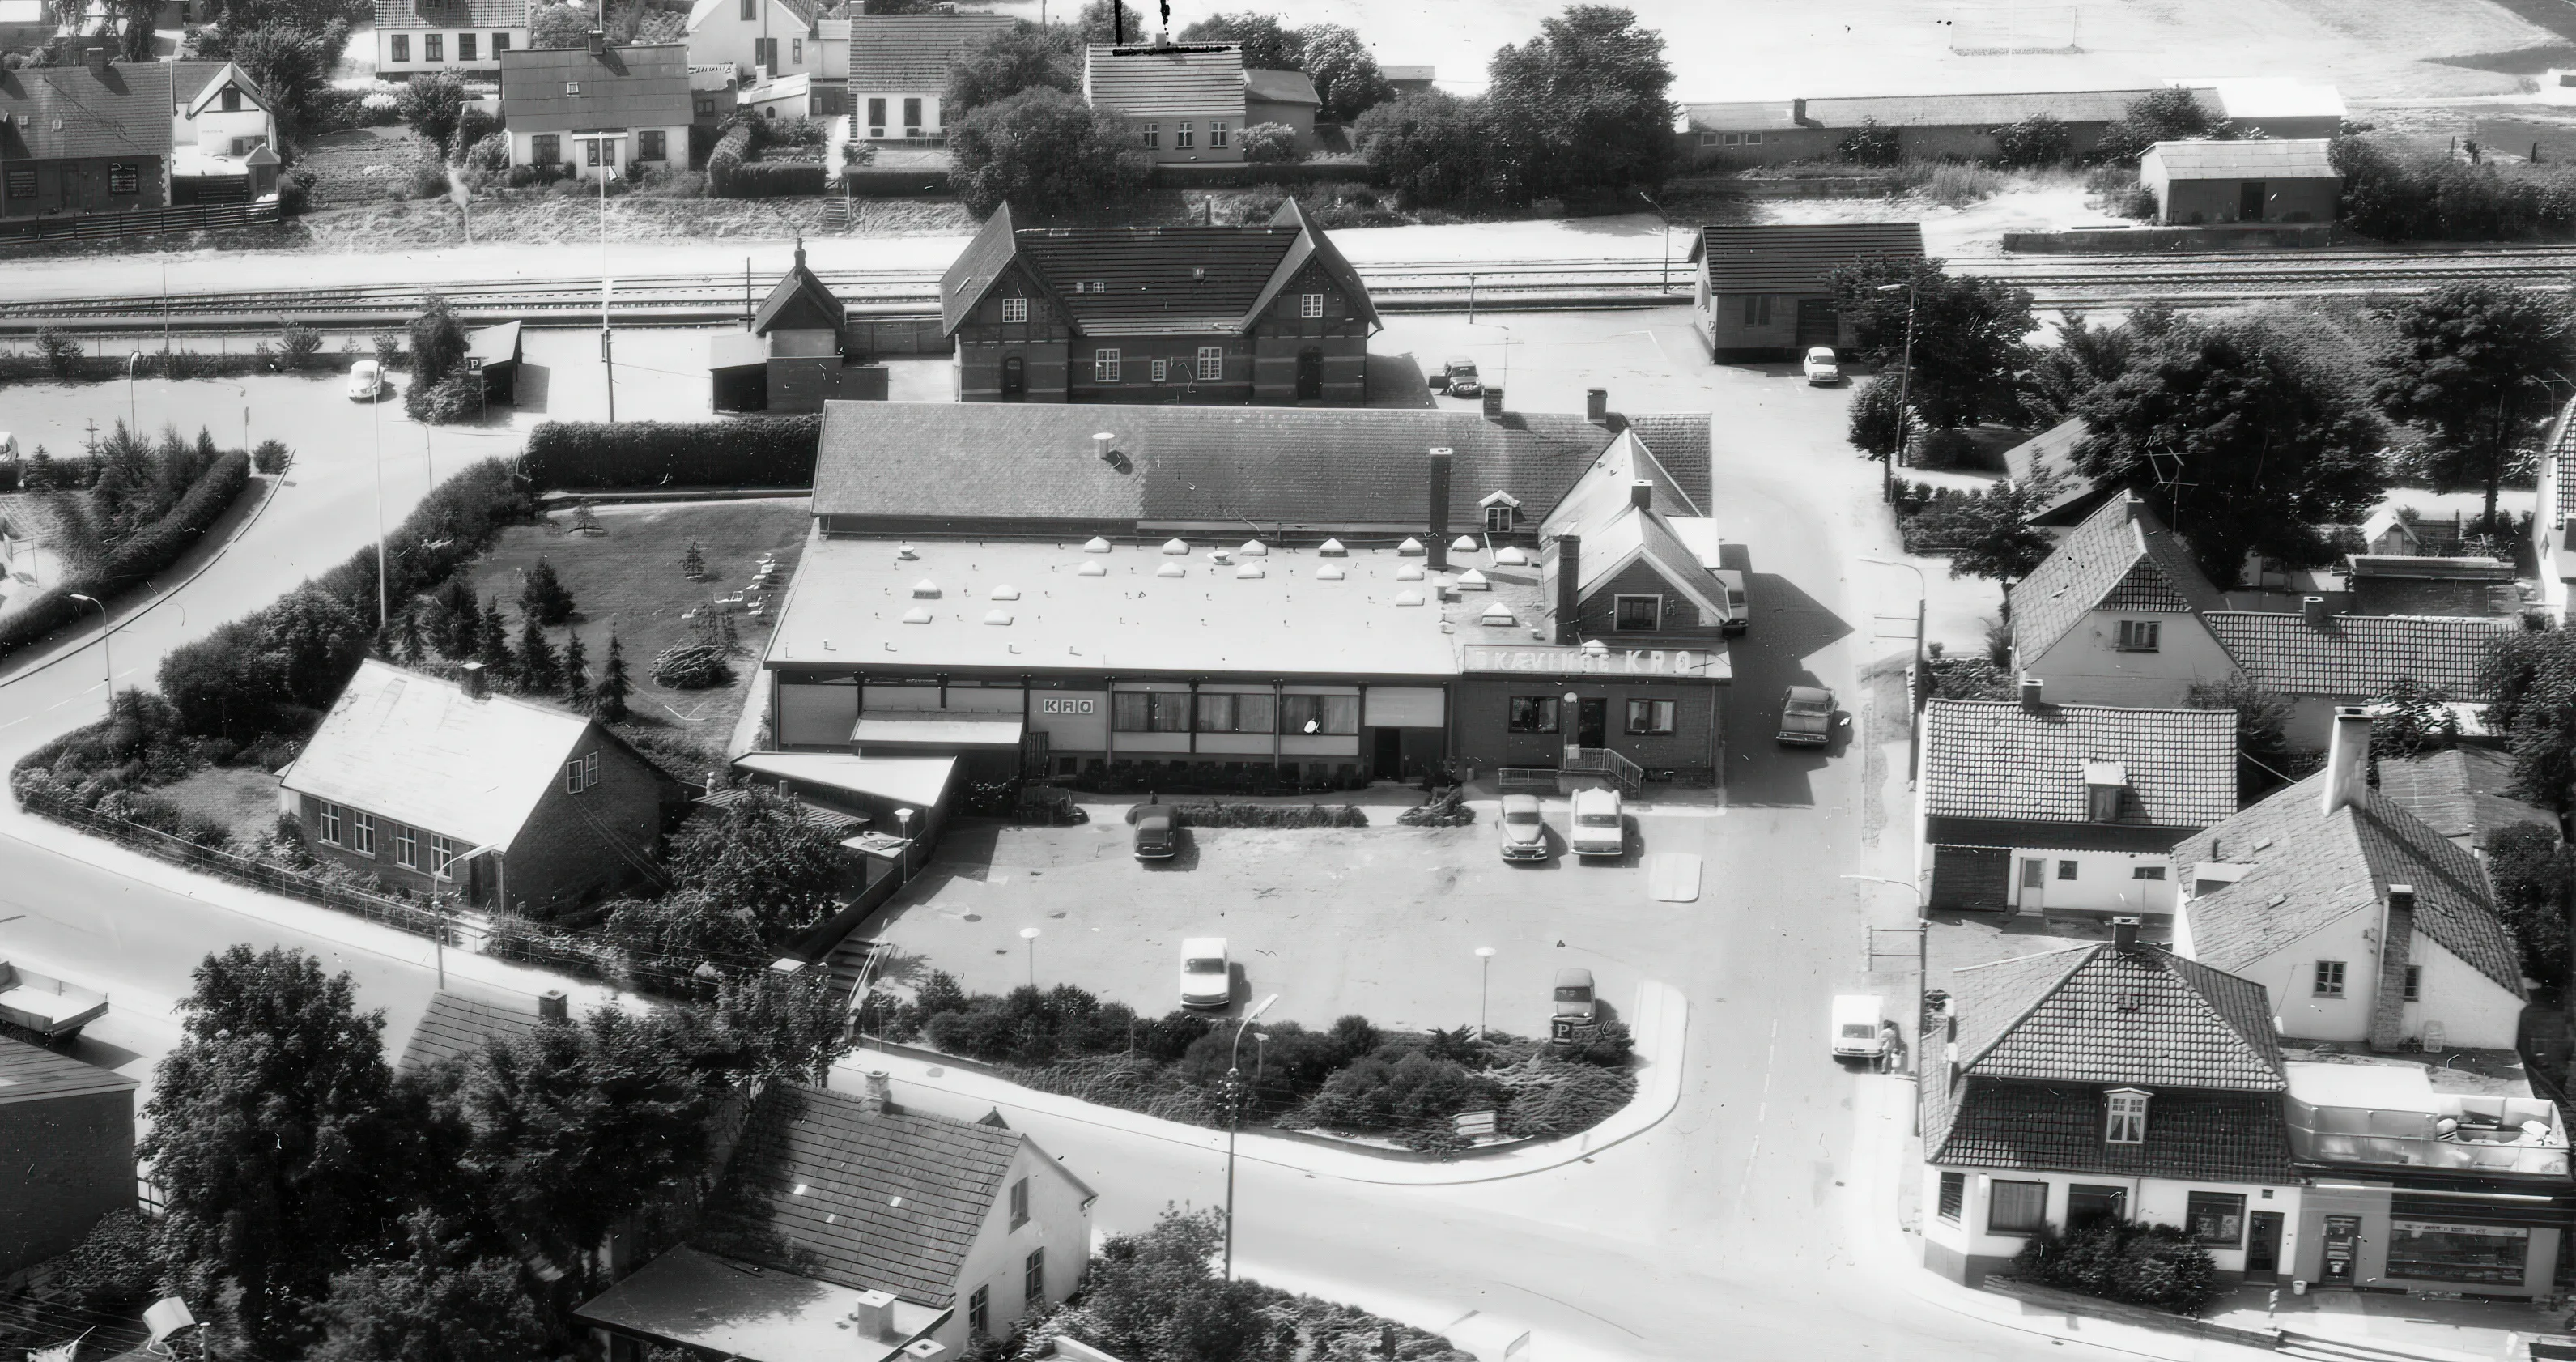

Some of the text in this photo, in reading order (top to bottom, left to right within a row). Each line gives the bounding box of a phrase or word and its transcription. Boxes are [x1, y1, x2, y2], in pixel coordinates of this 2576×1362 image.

[470, 360, 479, 369] P
[1625, 649, 1692, 674] KRO
[1044, 700, 1092, 713] KRO
[1557, 1024, 1570, 1037] P
